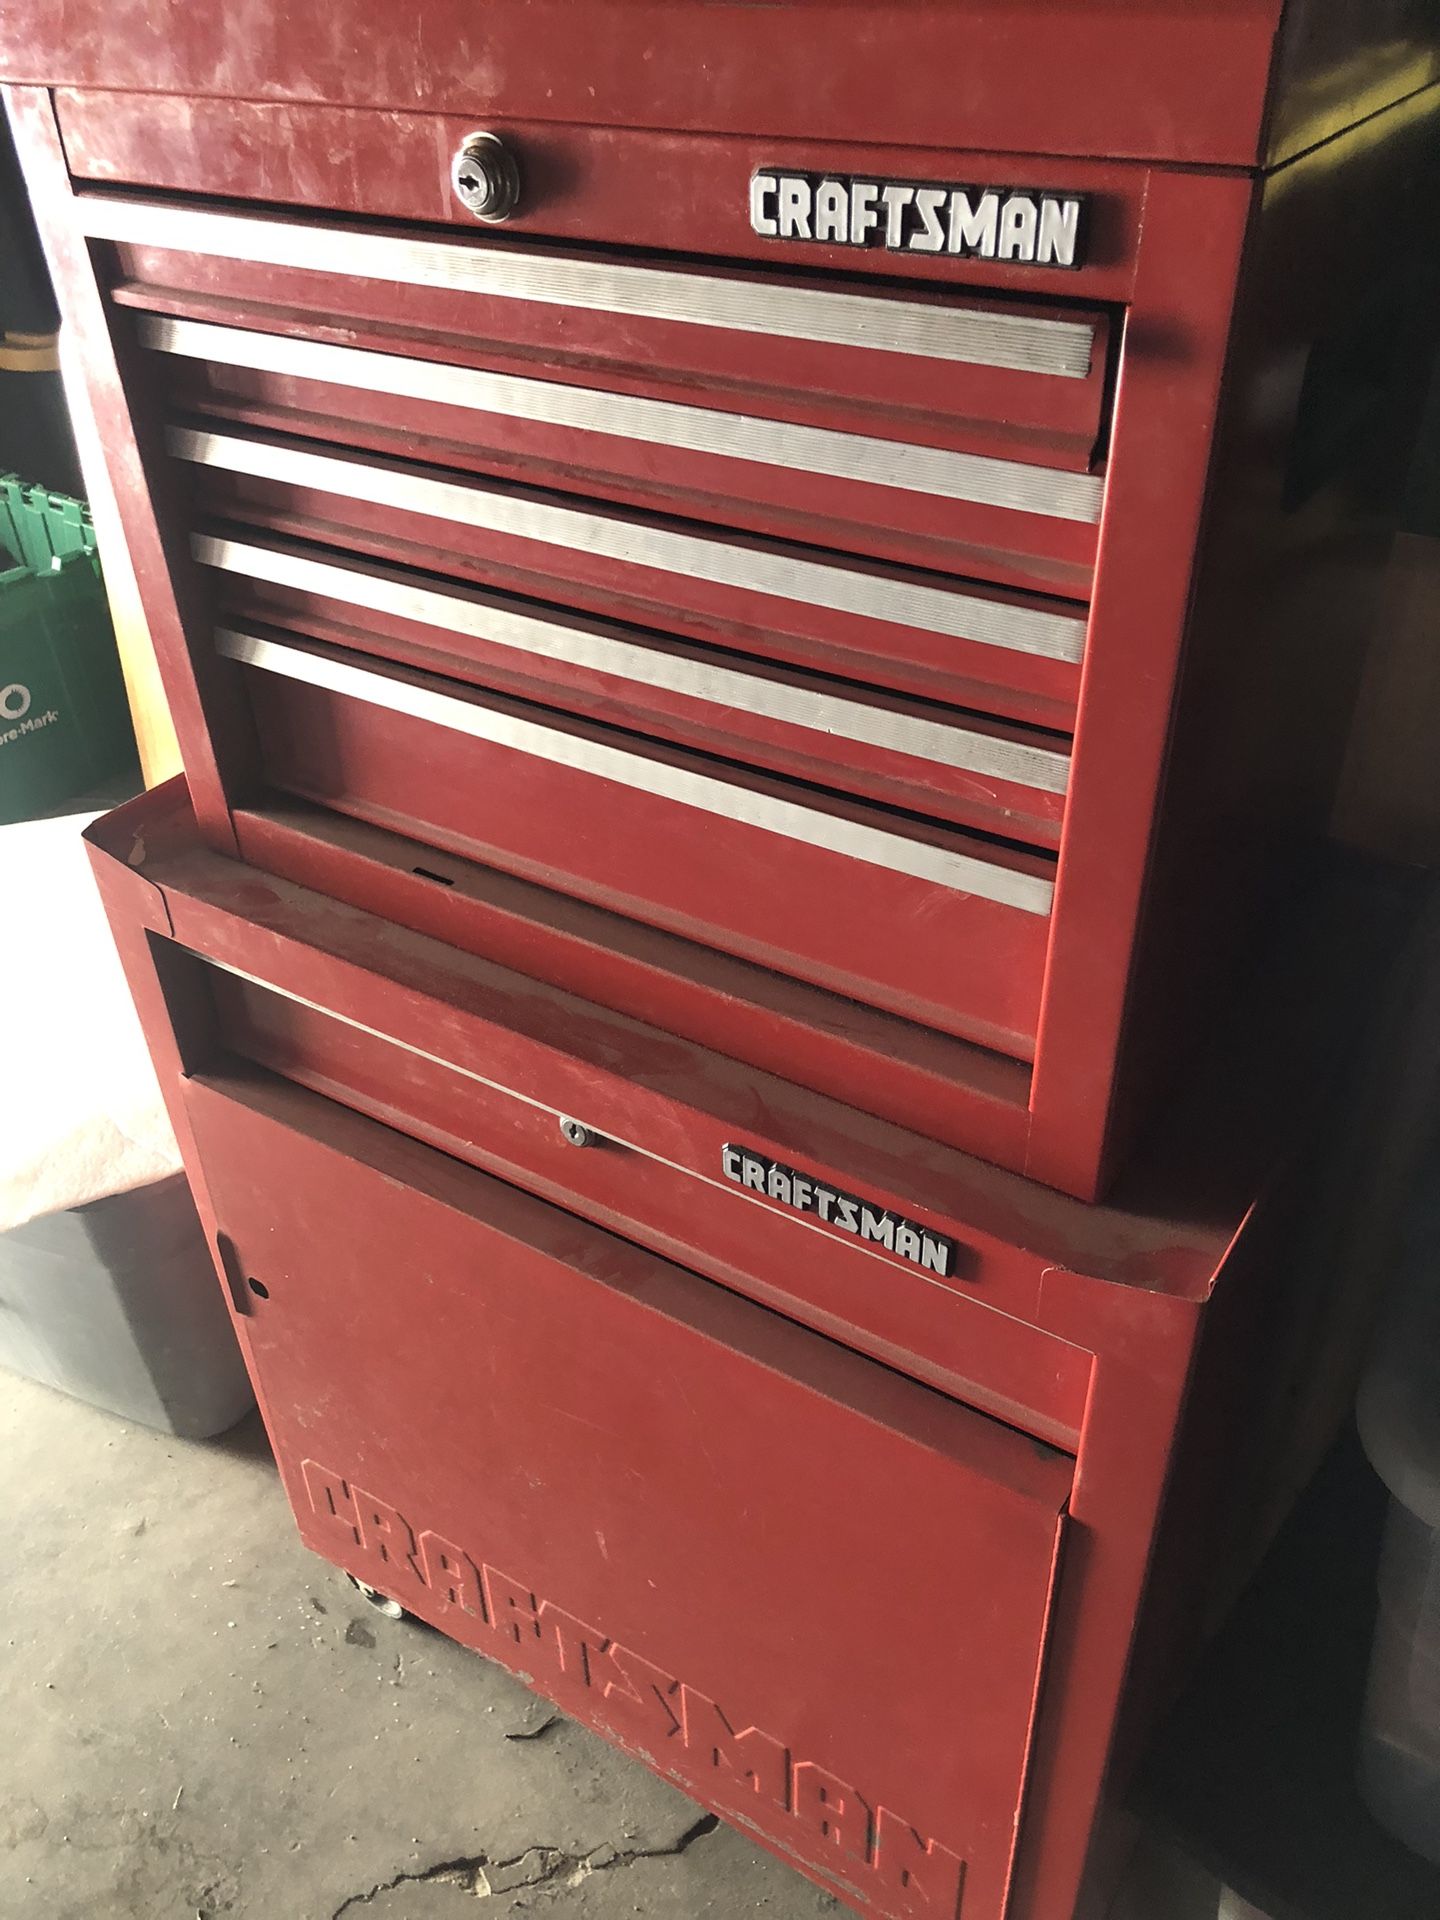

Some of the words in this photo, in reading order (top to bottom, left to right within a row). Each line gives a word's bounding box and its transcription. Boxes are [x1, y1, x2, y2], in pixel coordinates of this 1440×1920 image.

[750, 174, 1080, 267] CRAFTSMAN
[722, 1146, 950, 1277] CRAFTSMAN
[300, 1458, 968, 1920] CRAFTSMAN
